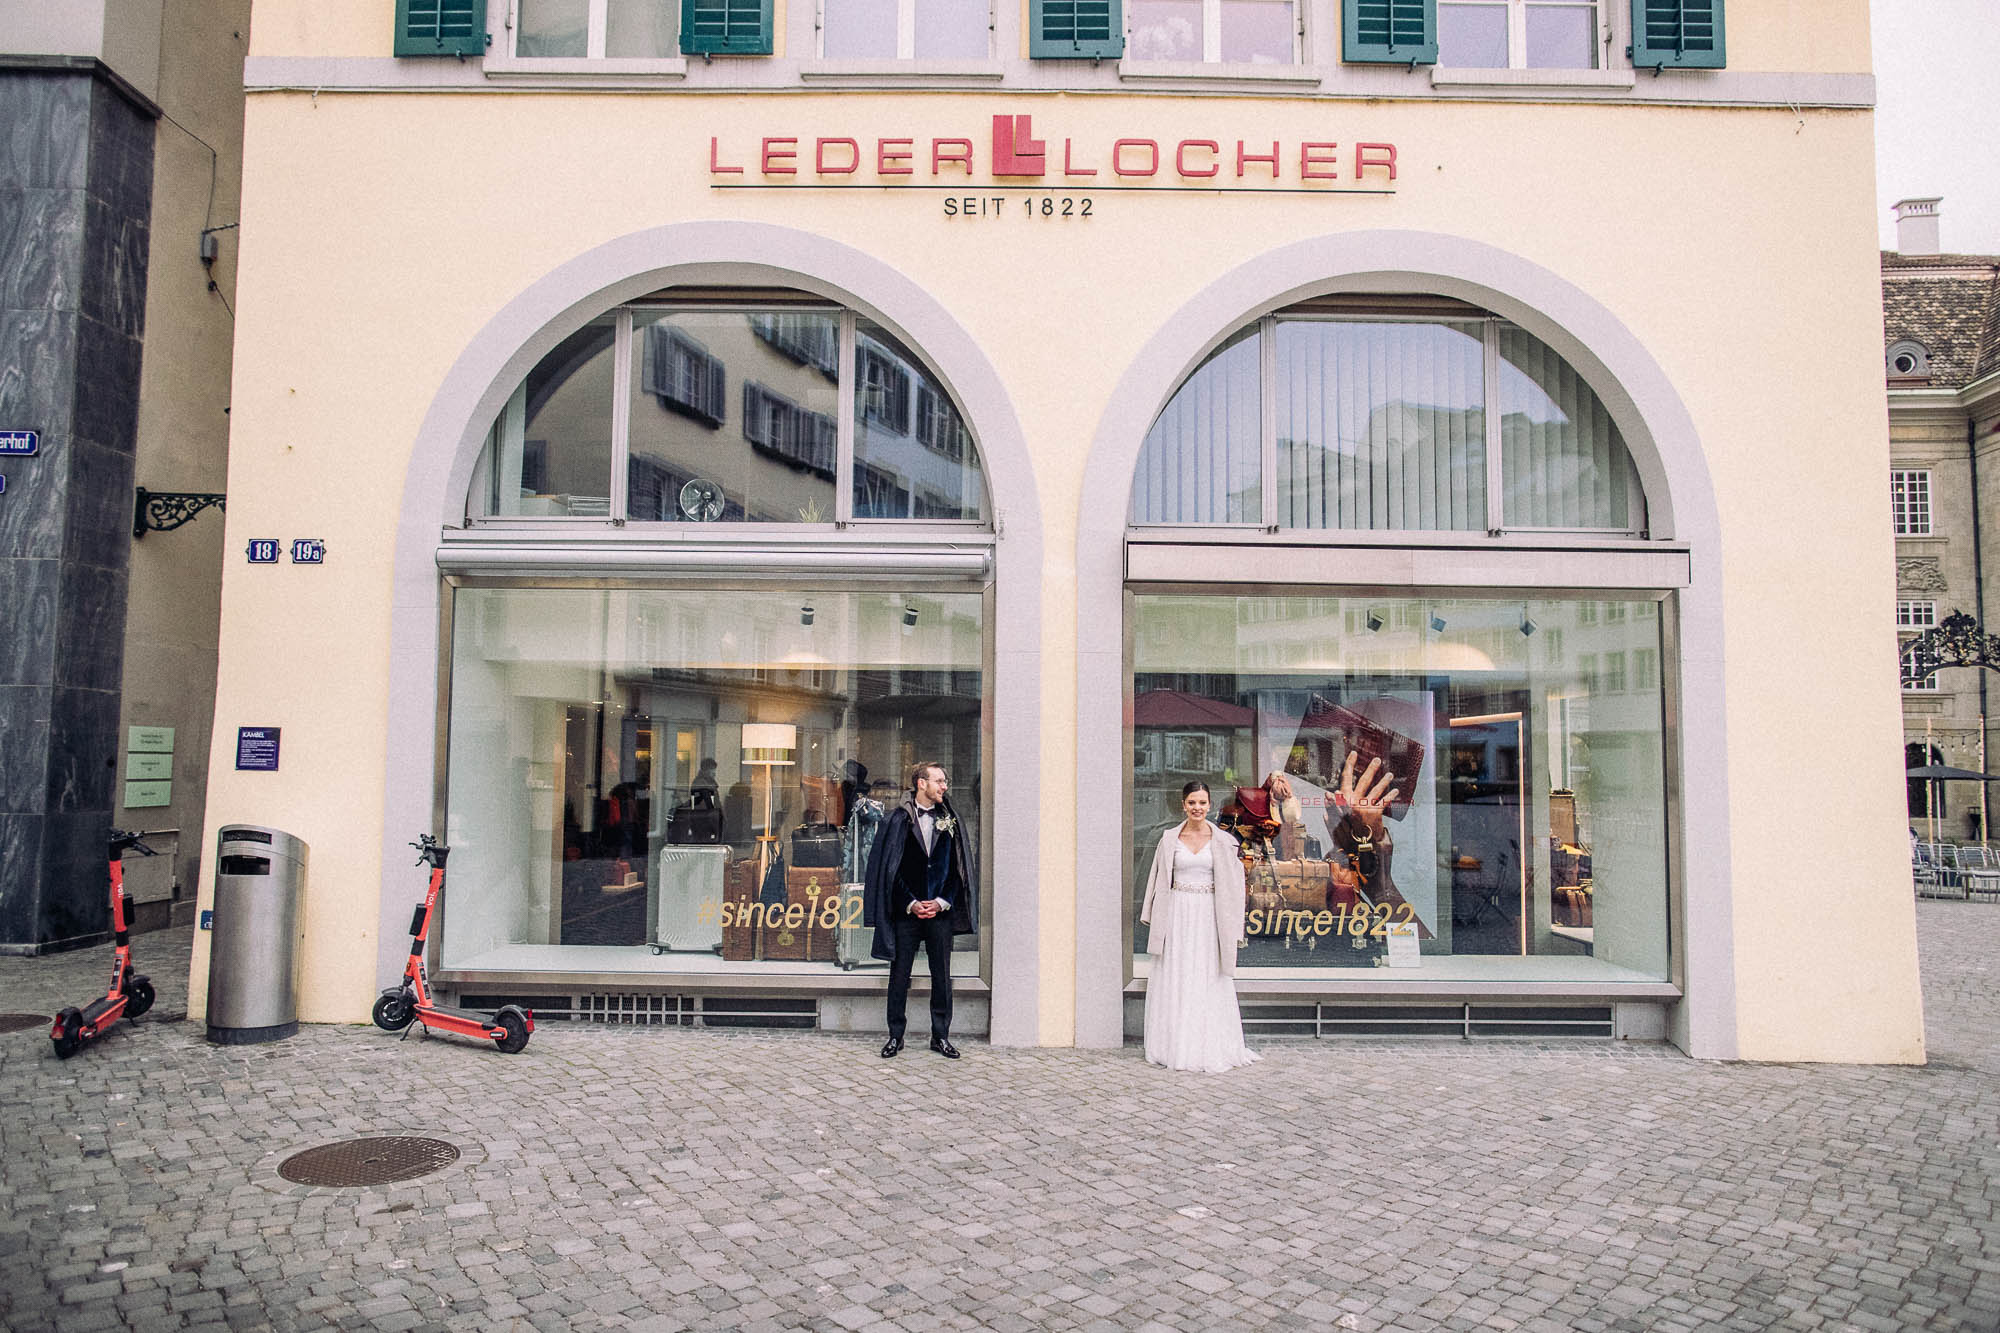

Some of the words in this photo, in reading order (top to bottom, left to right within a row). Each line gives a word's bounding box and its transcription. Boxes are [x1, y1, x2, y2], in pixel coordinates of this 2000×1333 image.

[710, 136, 973, 175] LEDER
[1064, 137, 1399, 180] LOCHER
[944, 197, 1005, 216] SEIT
[1024, 197, 1094, 216] 1822
[255, 542, 272, 560] 18
[295, 542, 320, 560] 19a
[1245, 902, 1415, 936] since1822
